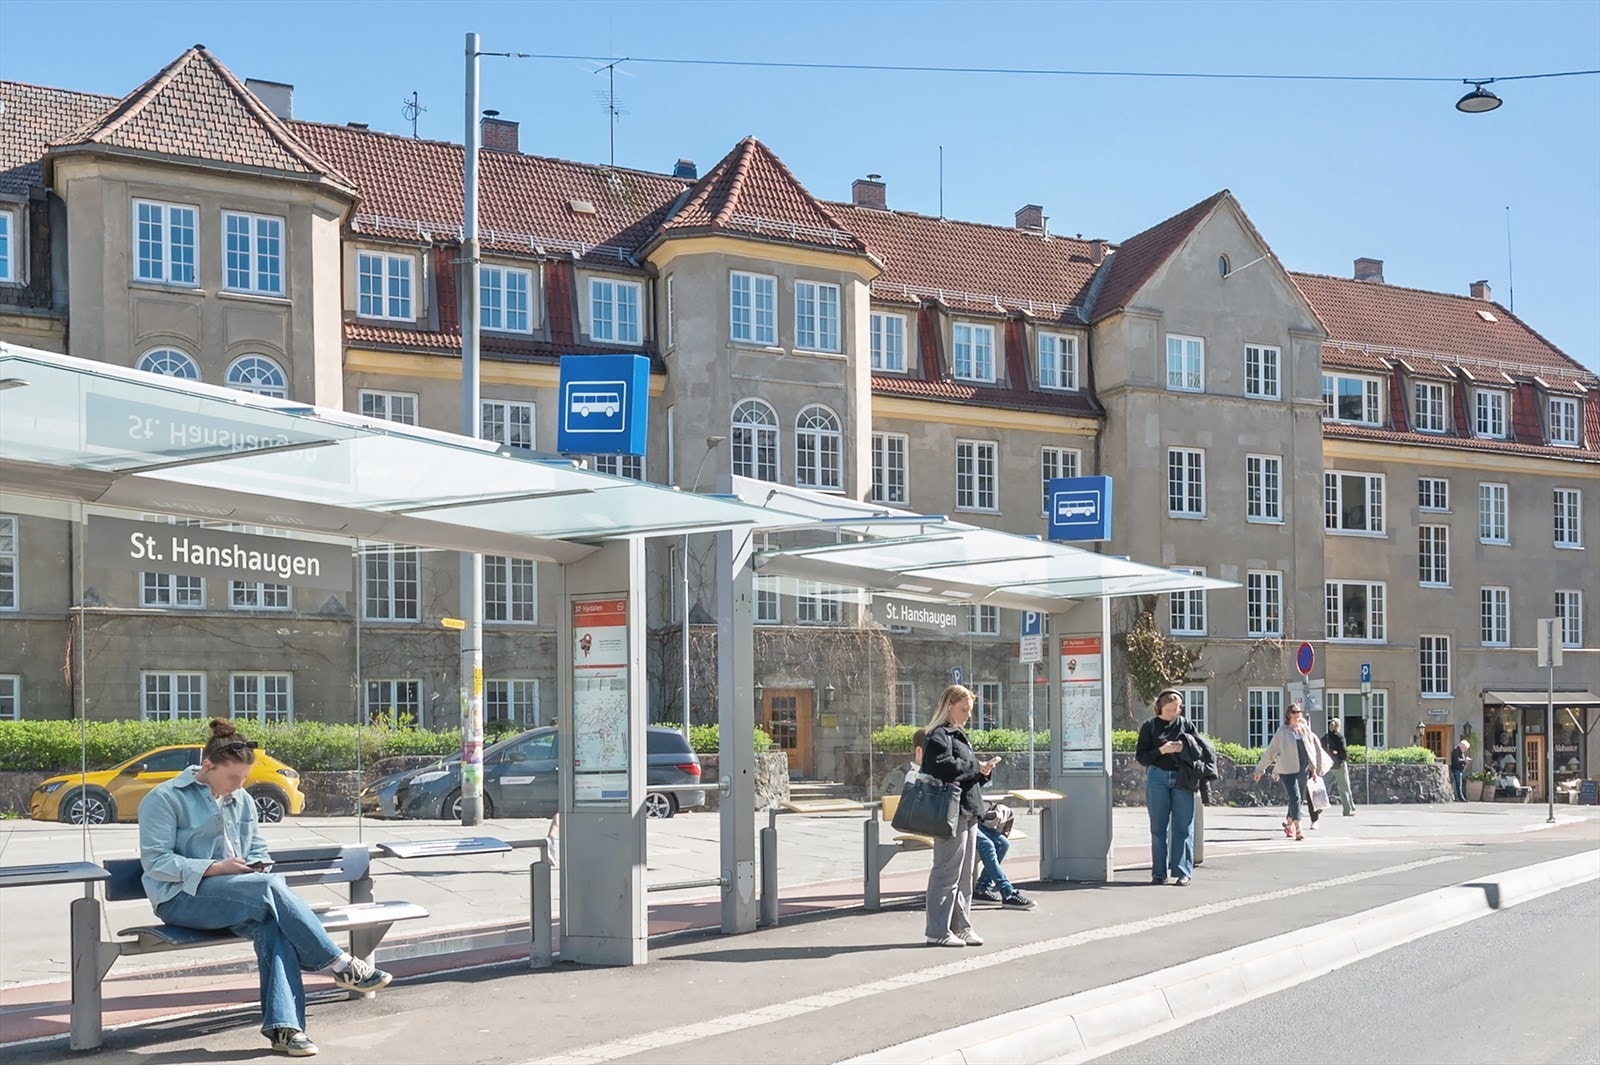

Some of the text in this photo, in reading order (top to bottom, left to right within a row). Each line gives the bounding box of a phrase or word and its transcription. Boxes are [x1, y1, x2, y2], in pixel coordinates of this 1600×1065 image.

[130, 531, 321, 580] St. Hanshaugen
[886, 602, 957, 628] St. Hanshaugen
[1025, 611, 1037, 633] P
[954, 669, 961, 684] P
[1362, 666, 1368, 680] P
